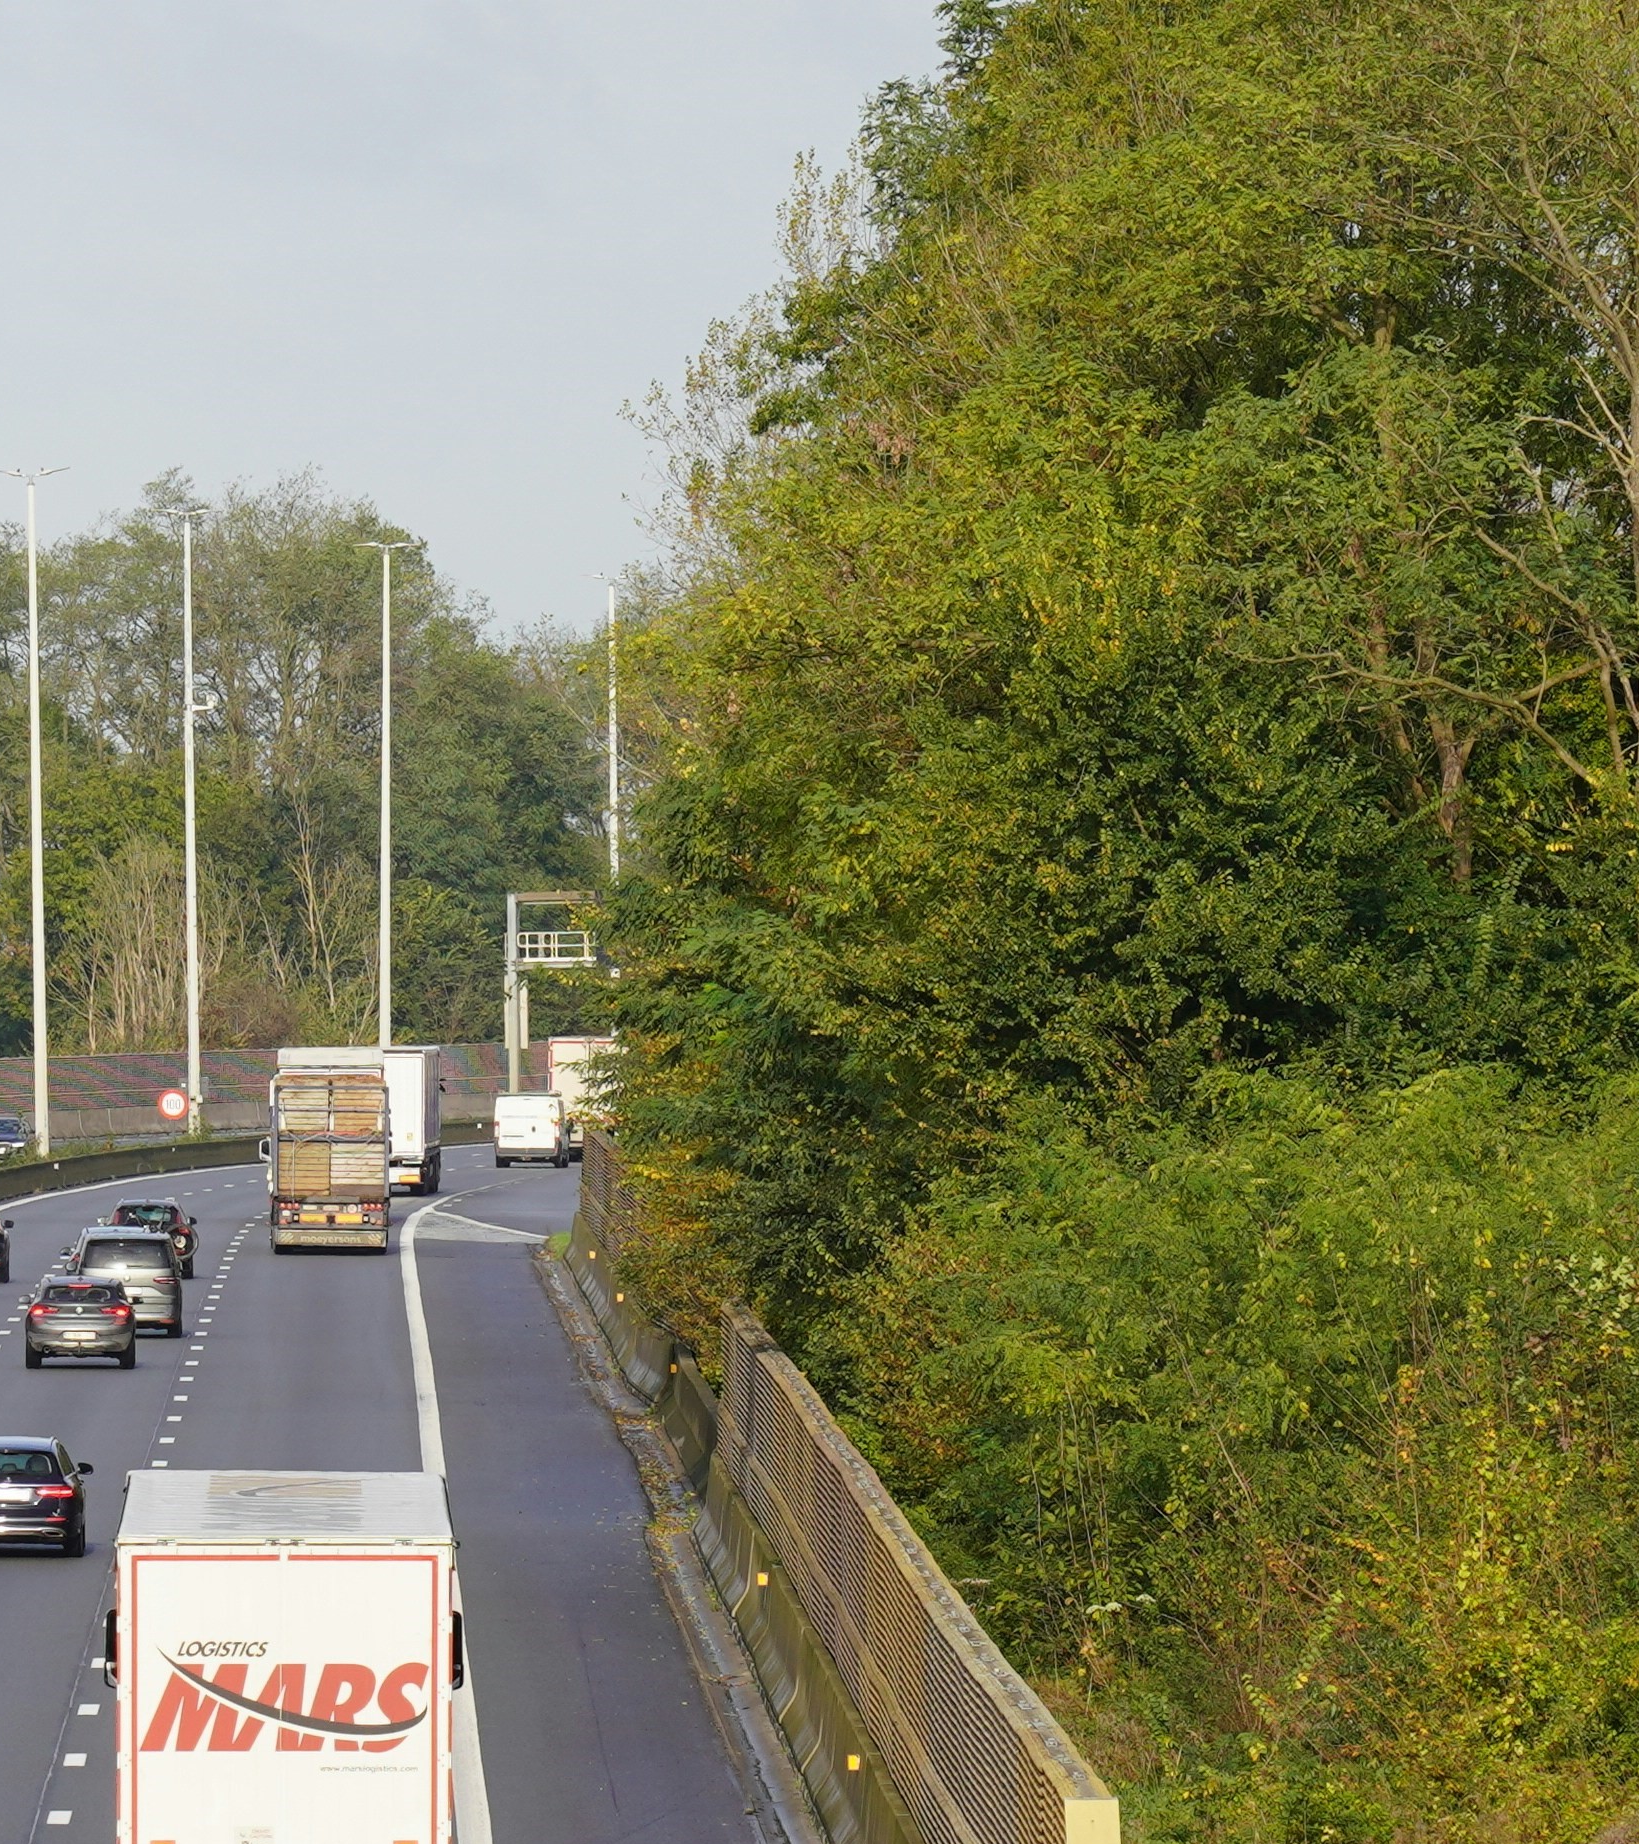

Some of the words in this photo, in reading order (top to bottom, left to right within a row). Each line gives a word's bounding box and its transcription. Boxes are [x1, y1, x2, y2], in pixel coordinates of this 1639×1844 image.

[166, 1098, 181, 1110] 100
[177, 1641, 269, 1657] LOGISTICS
[139, 1661, 429, 1753] MARS
